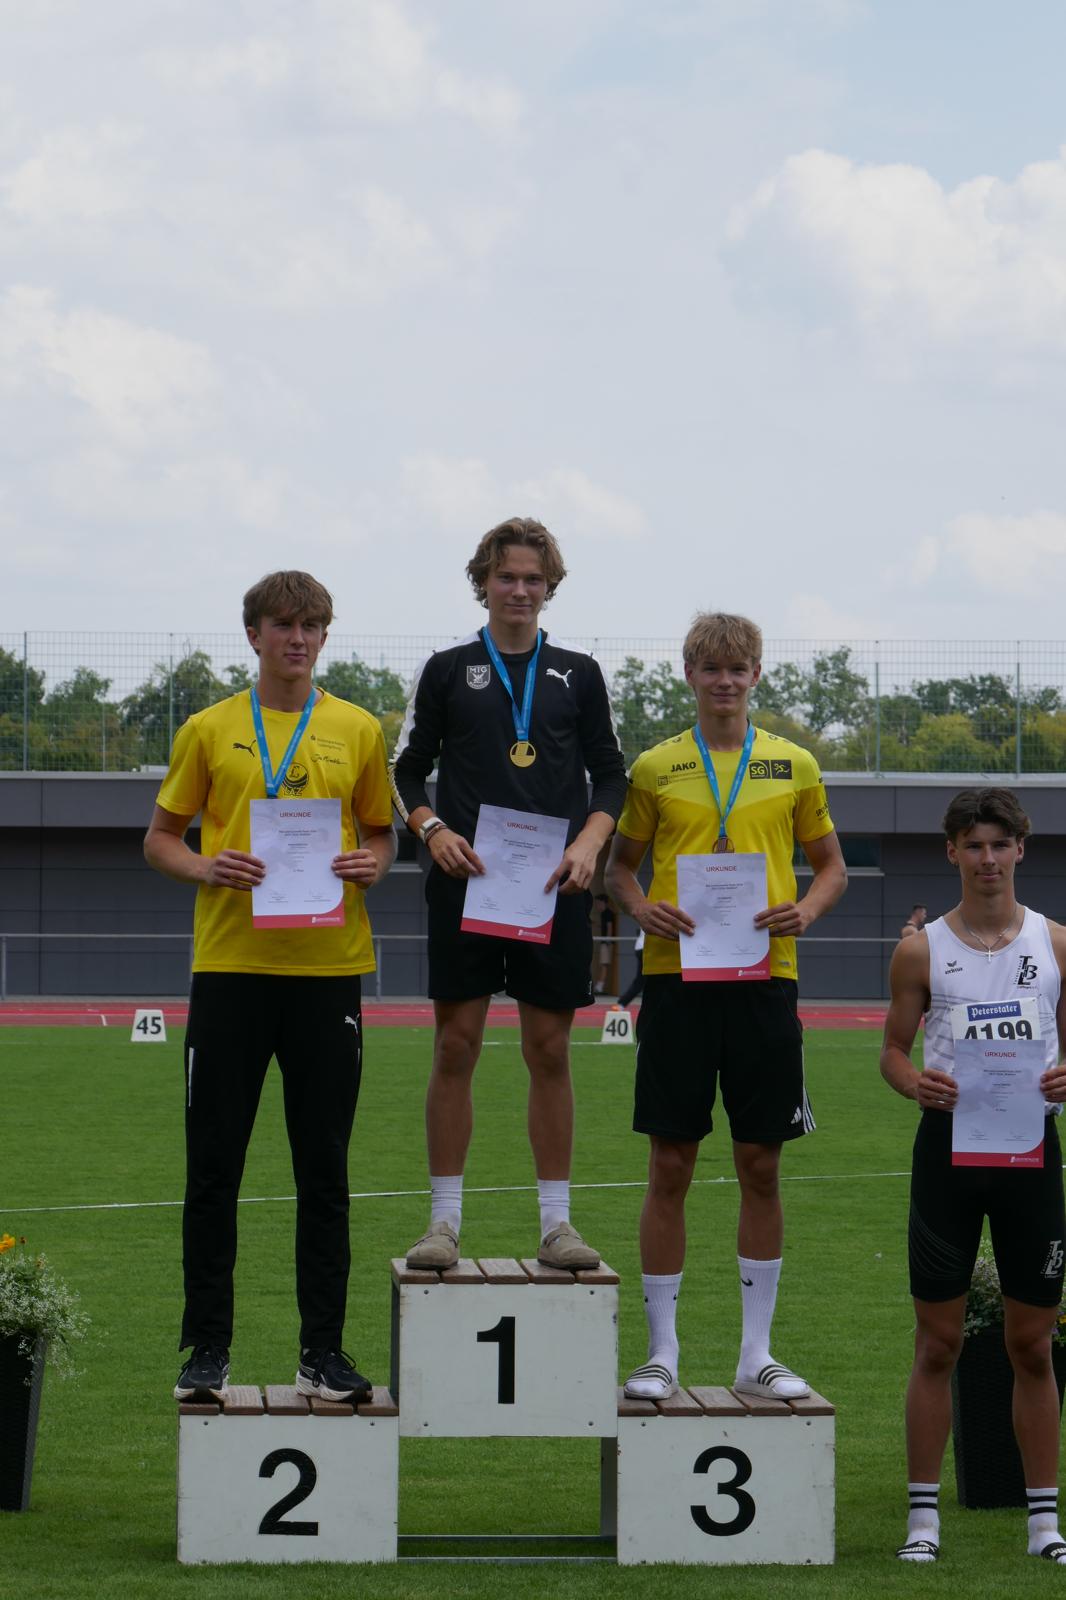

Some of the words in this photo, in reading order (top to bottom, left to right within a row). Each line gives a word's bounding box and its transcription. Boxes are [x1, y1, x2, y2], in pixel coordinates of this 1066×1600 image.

[671, 761, 696, 772] JAKO
[751, 766, 765, 775] SG
[506, 821, 539, 832] URKUNDE
[705, 865, 737, 873] URKUNDE
[971, 1005, 1018, 1018] Peterstaler
[136, 1015, 162, 1035] 45
[606, 1018, 628, 1037] 40
[476, 1316, 516, 1405] 1
[258, 1447, 320, 1536] 2
[690, 1445, 757, 1537] 3
